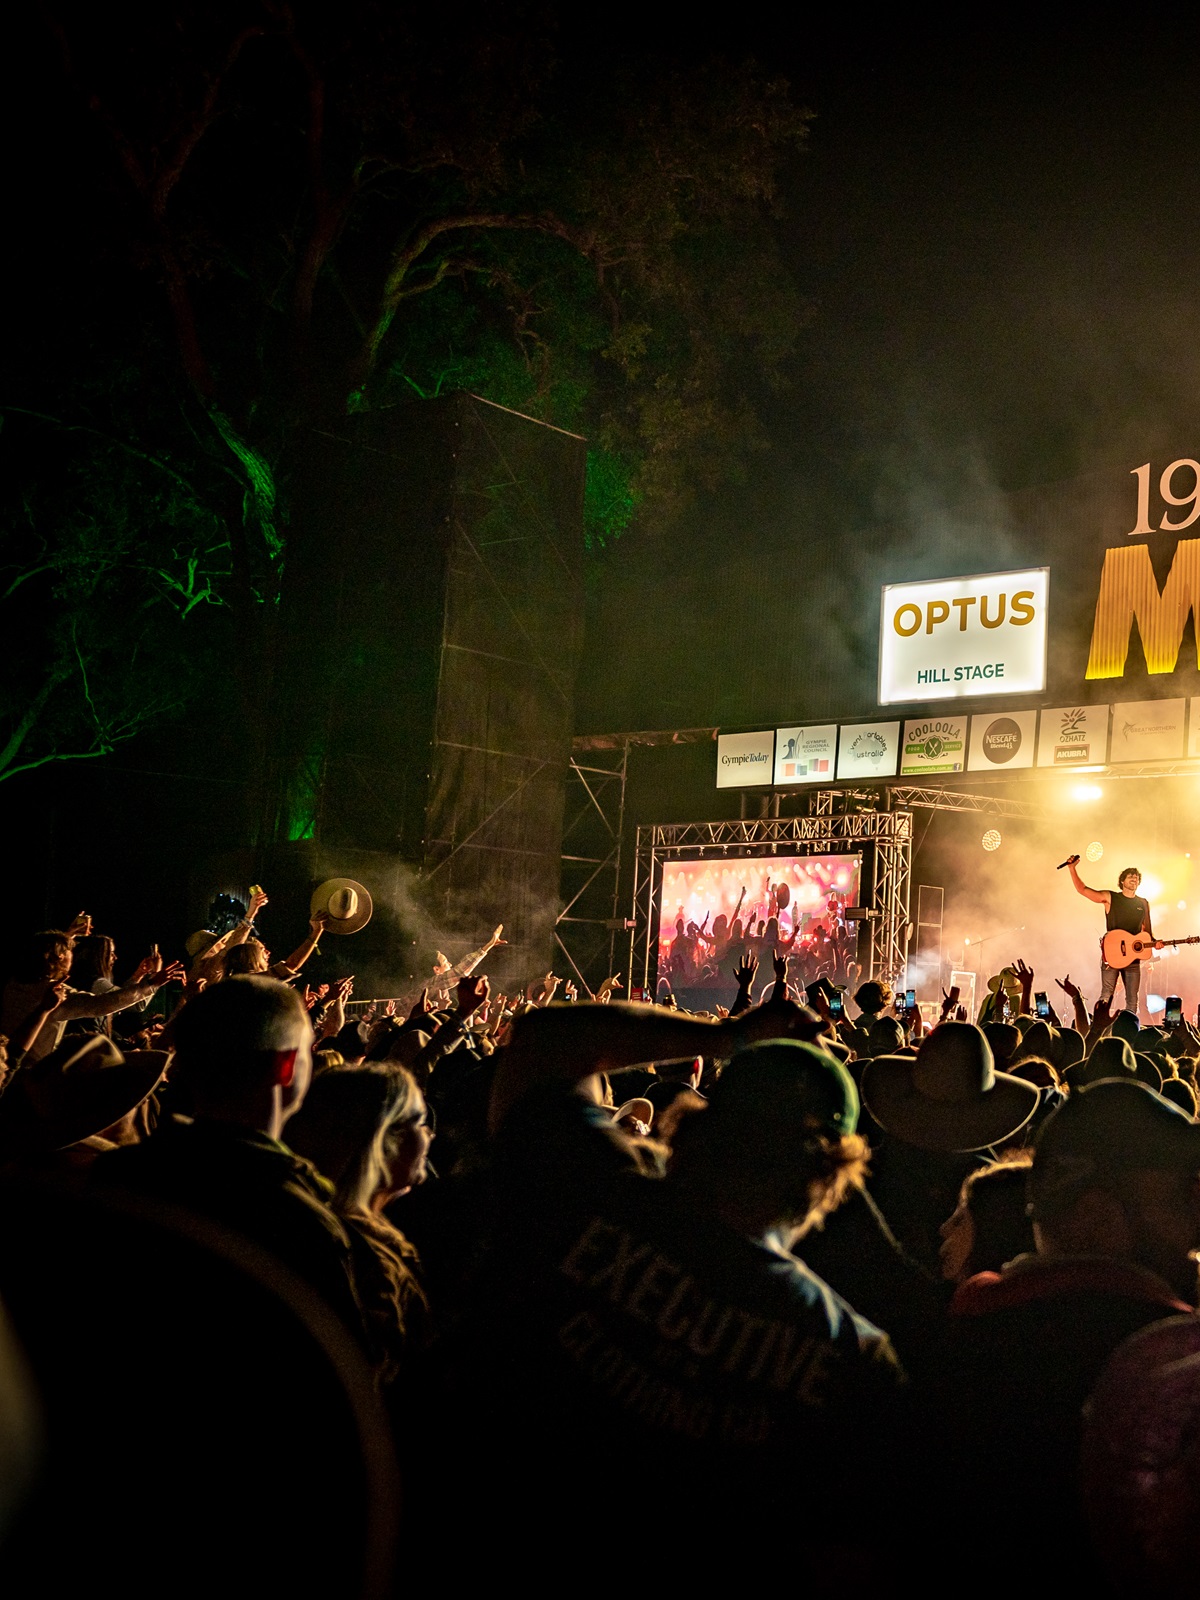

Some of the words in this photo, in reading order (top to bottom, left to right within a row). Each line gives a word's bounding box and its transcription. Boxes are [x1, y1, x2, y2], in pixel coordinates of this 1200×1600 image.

[893, 591, 1035, 637] OPTUS
[917, 669, 950, 684] HILL
[954, 663, 1004, 681] STAGE
[908, 722, 961, 741] COOLOOLA
[1060, 734, 1086, 743] OZHATZ
[856, 749, 884, 758] ustralia
[1056, 749, 1087, 758] AKUBRA
[558, 1215, 842, 1408] EXECUTIVE
